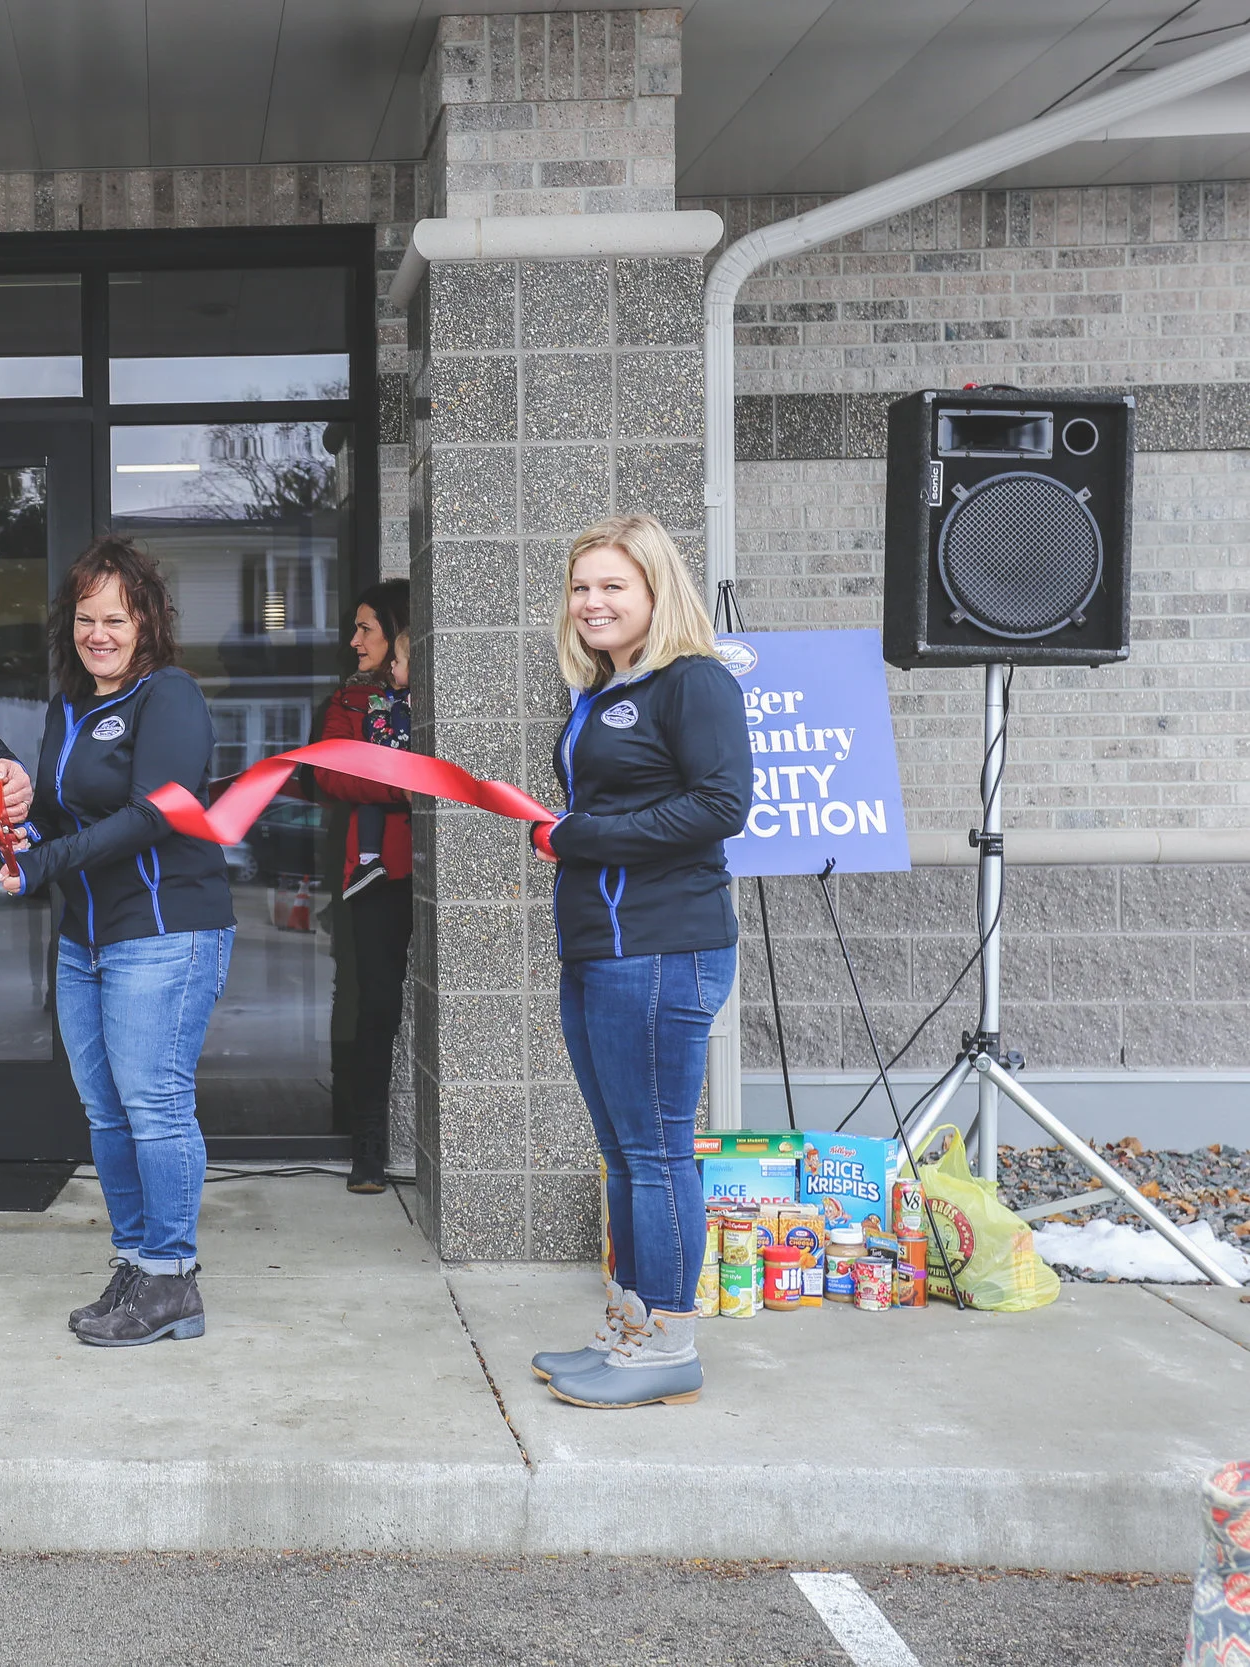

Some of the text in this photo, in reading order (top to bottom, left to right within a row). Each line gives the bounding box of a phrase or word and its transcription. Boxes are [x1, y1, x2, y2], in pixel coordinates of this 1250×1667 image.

[744, 686, 804, 726] ger
[750, 722, 856, 761] antry
[752, 765, 836, 801] RITY
[731, 800, 887, 839] CTION
[823, 1160, 863, 1181] RICE
[713, 1184, 747, 1197] RICE
[808, 1176, 879, 1202] KRISPIES
[903, 1191, 920, 1210] V8
[931, 1200, 958, 1222] BROS.
